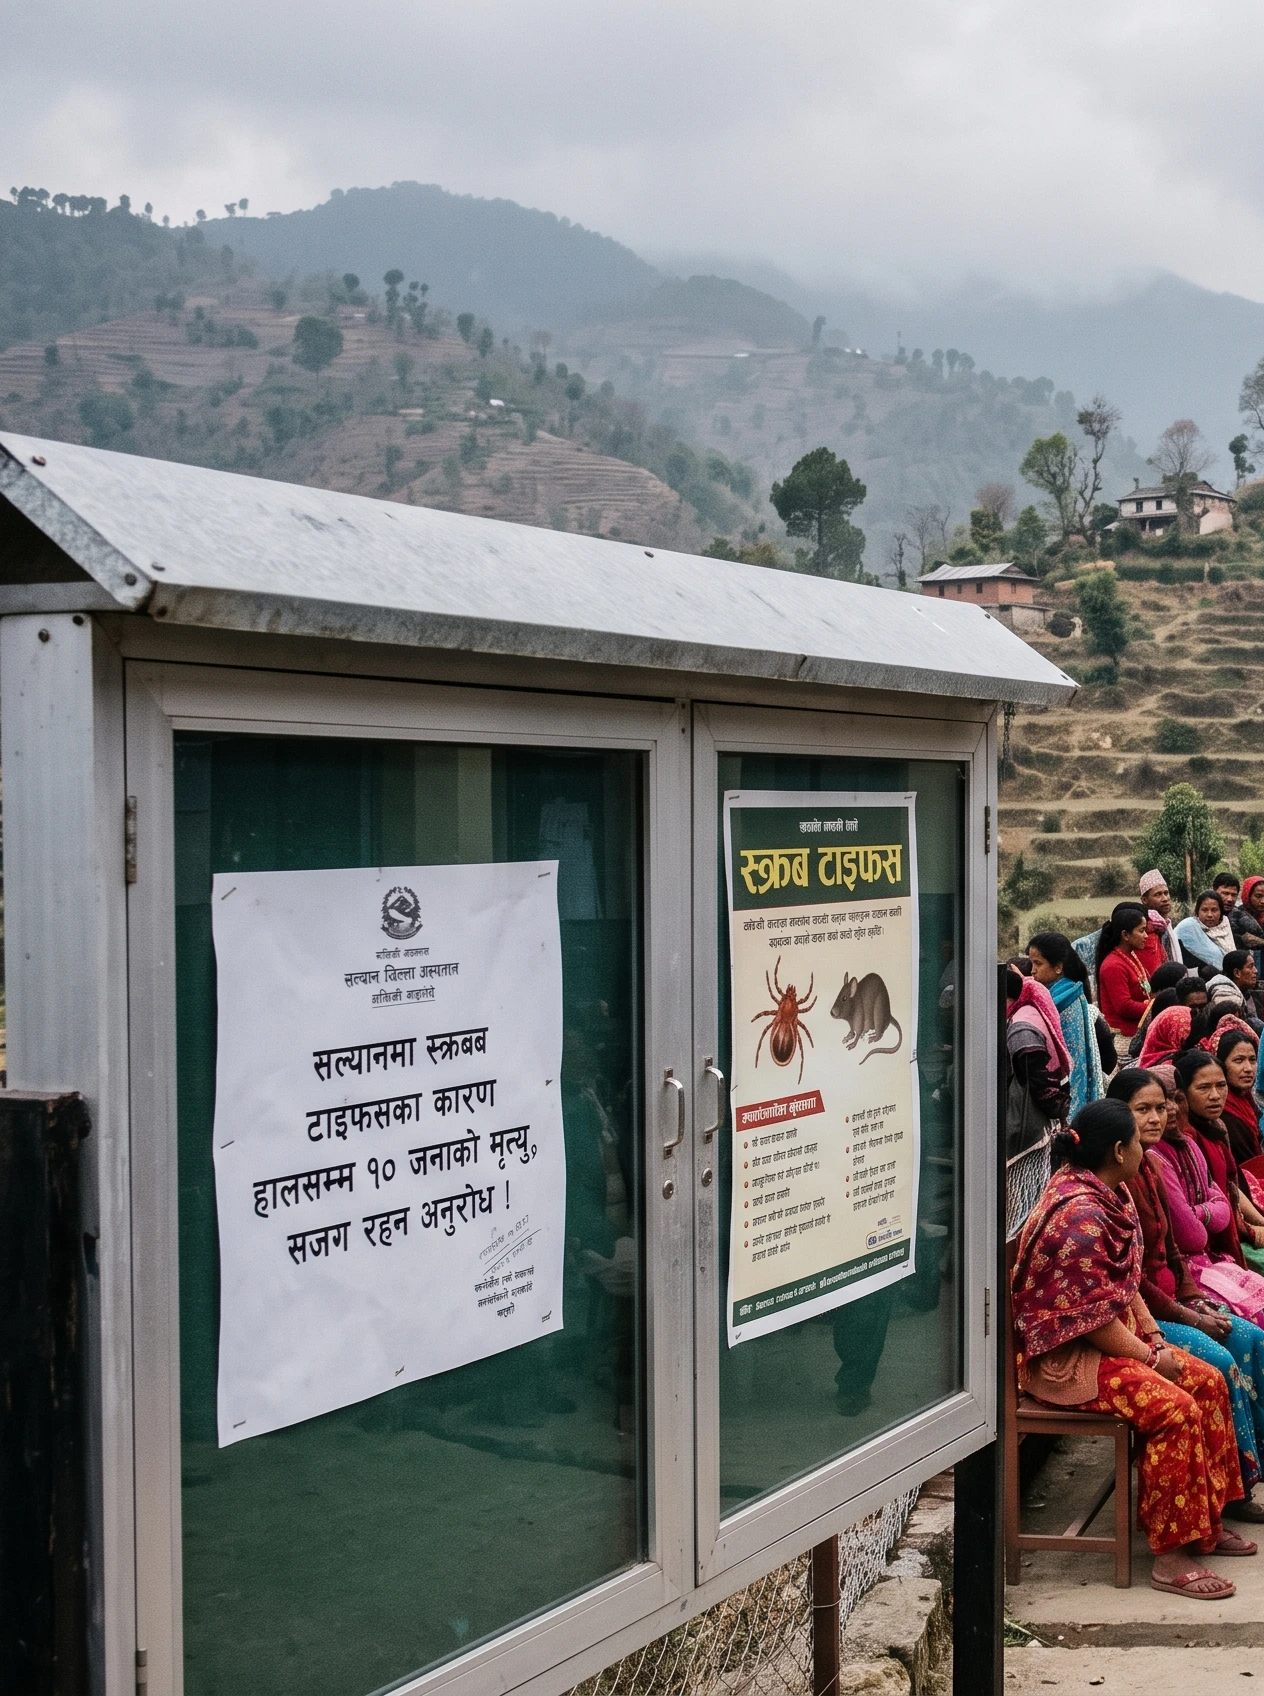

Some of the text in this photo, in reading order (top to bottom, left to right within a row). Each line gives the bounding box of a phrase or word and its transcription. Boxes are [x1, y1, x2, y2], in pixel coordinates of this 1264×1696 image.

[817, 844, 903, 891] टाइफस
[313, 1037, 417, 1082] सल्यानमा
[306, 1078, 497, 1142] टाइफसका कारण
[253, 1162, 356, 1218] हालसम्म
[367, 1157, 397, 1190] १०
[408, 1128, 481, 1176] जनाको
[287, 1221, 351, 1265] सजग
[363, 1207, 411, 1247] रहन
[421, 1184, 495, 1237] अनुरोध
[505, 1179, 511, 1210] !
